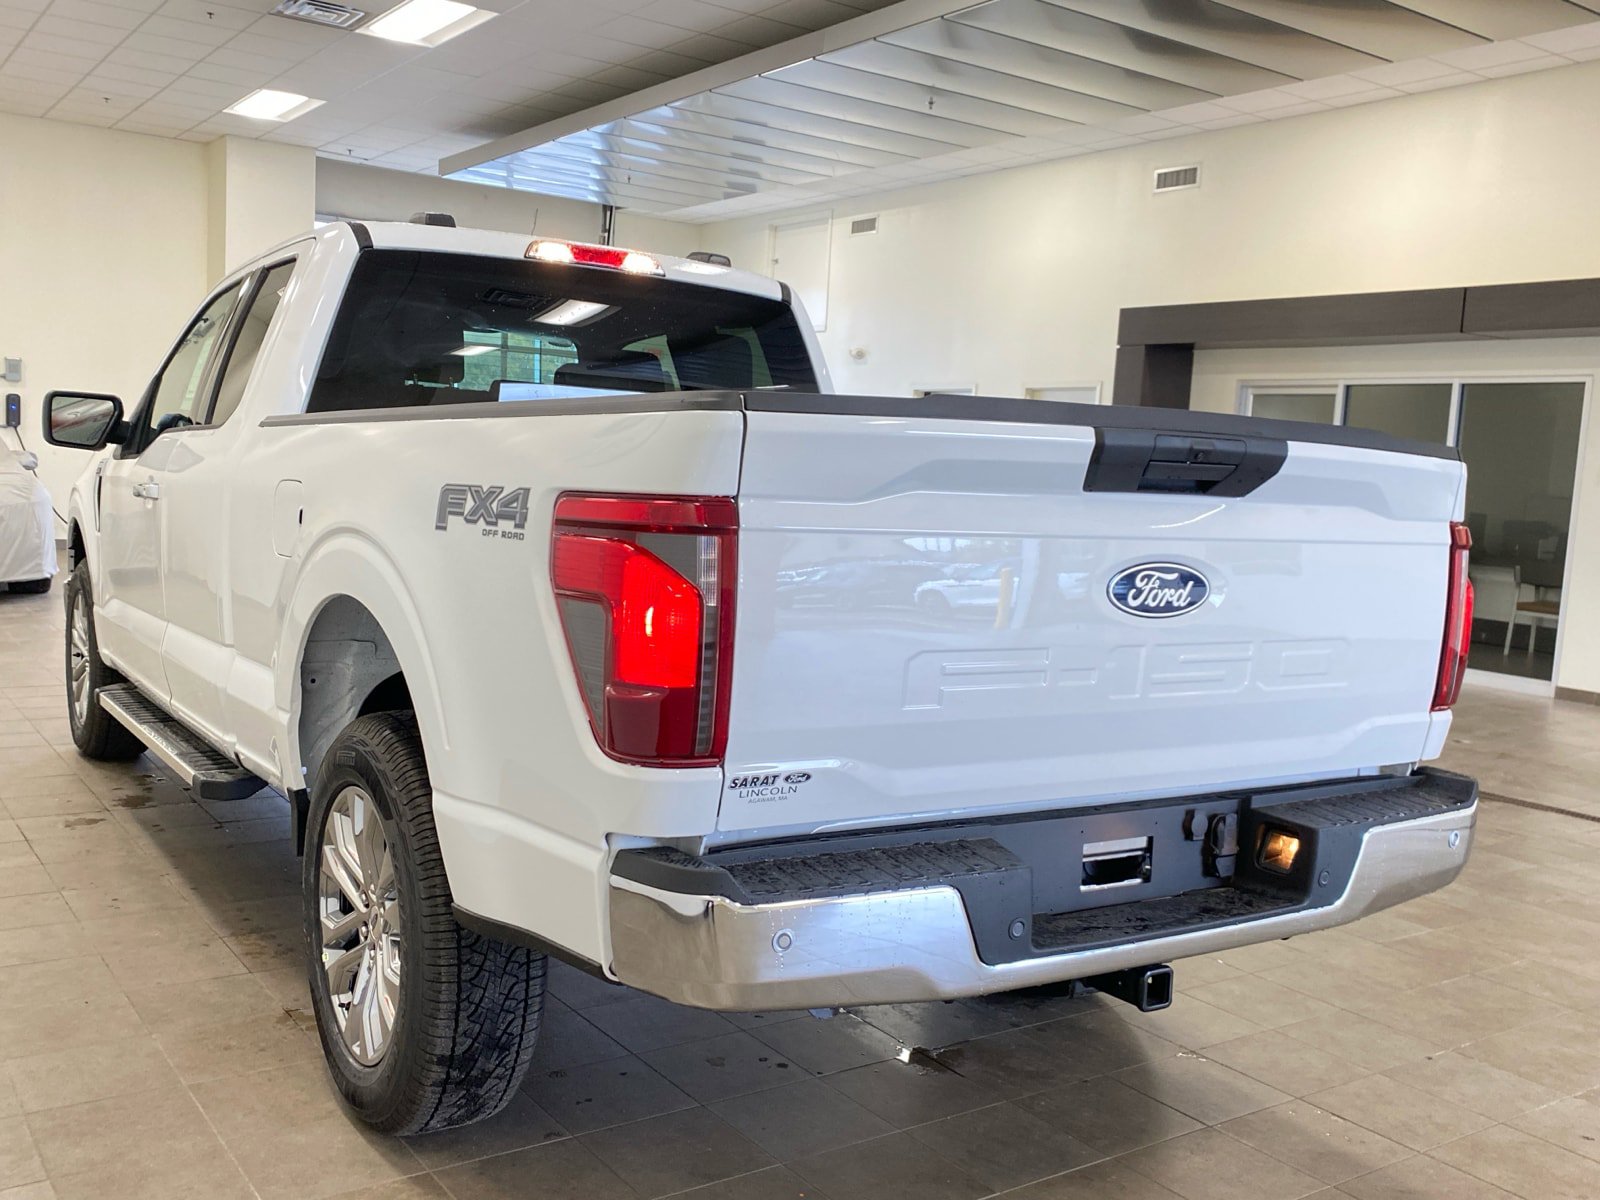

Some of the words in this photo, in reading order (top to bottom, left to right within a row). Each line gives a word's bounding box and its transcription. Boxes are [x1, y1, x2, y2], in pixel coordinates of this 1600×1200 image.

[435, 483, 531, 531] FX4
[482, 528, 499, 538] OFF
[501, 530, 525, 541] ROAD
[1127, 570, 1194, 607] Ford
[902, 638, 1350, 712] F-150
[729, 774, 780, 789] SARAT
[739, 785, 798, 799] LINCOLN
